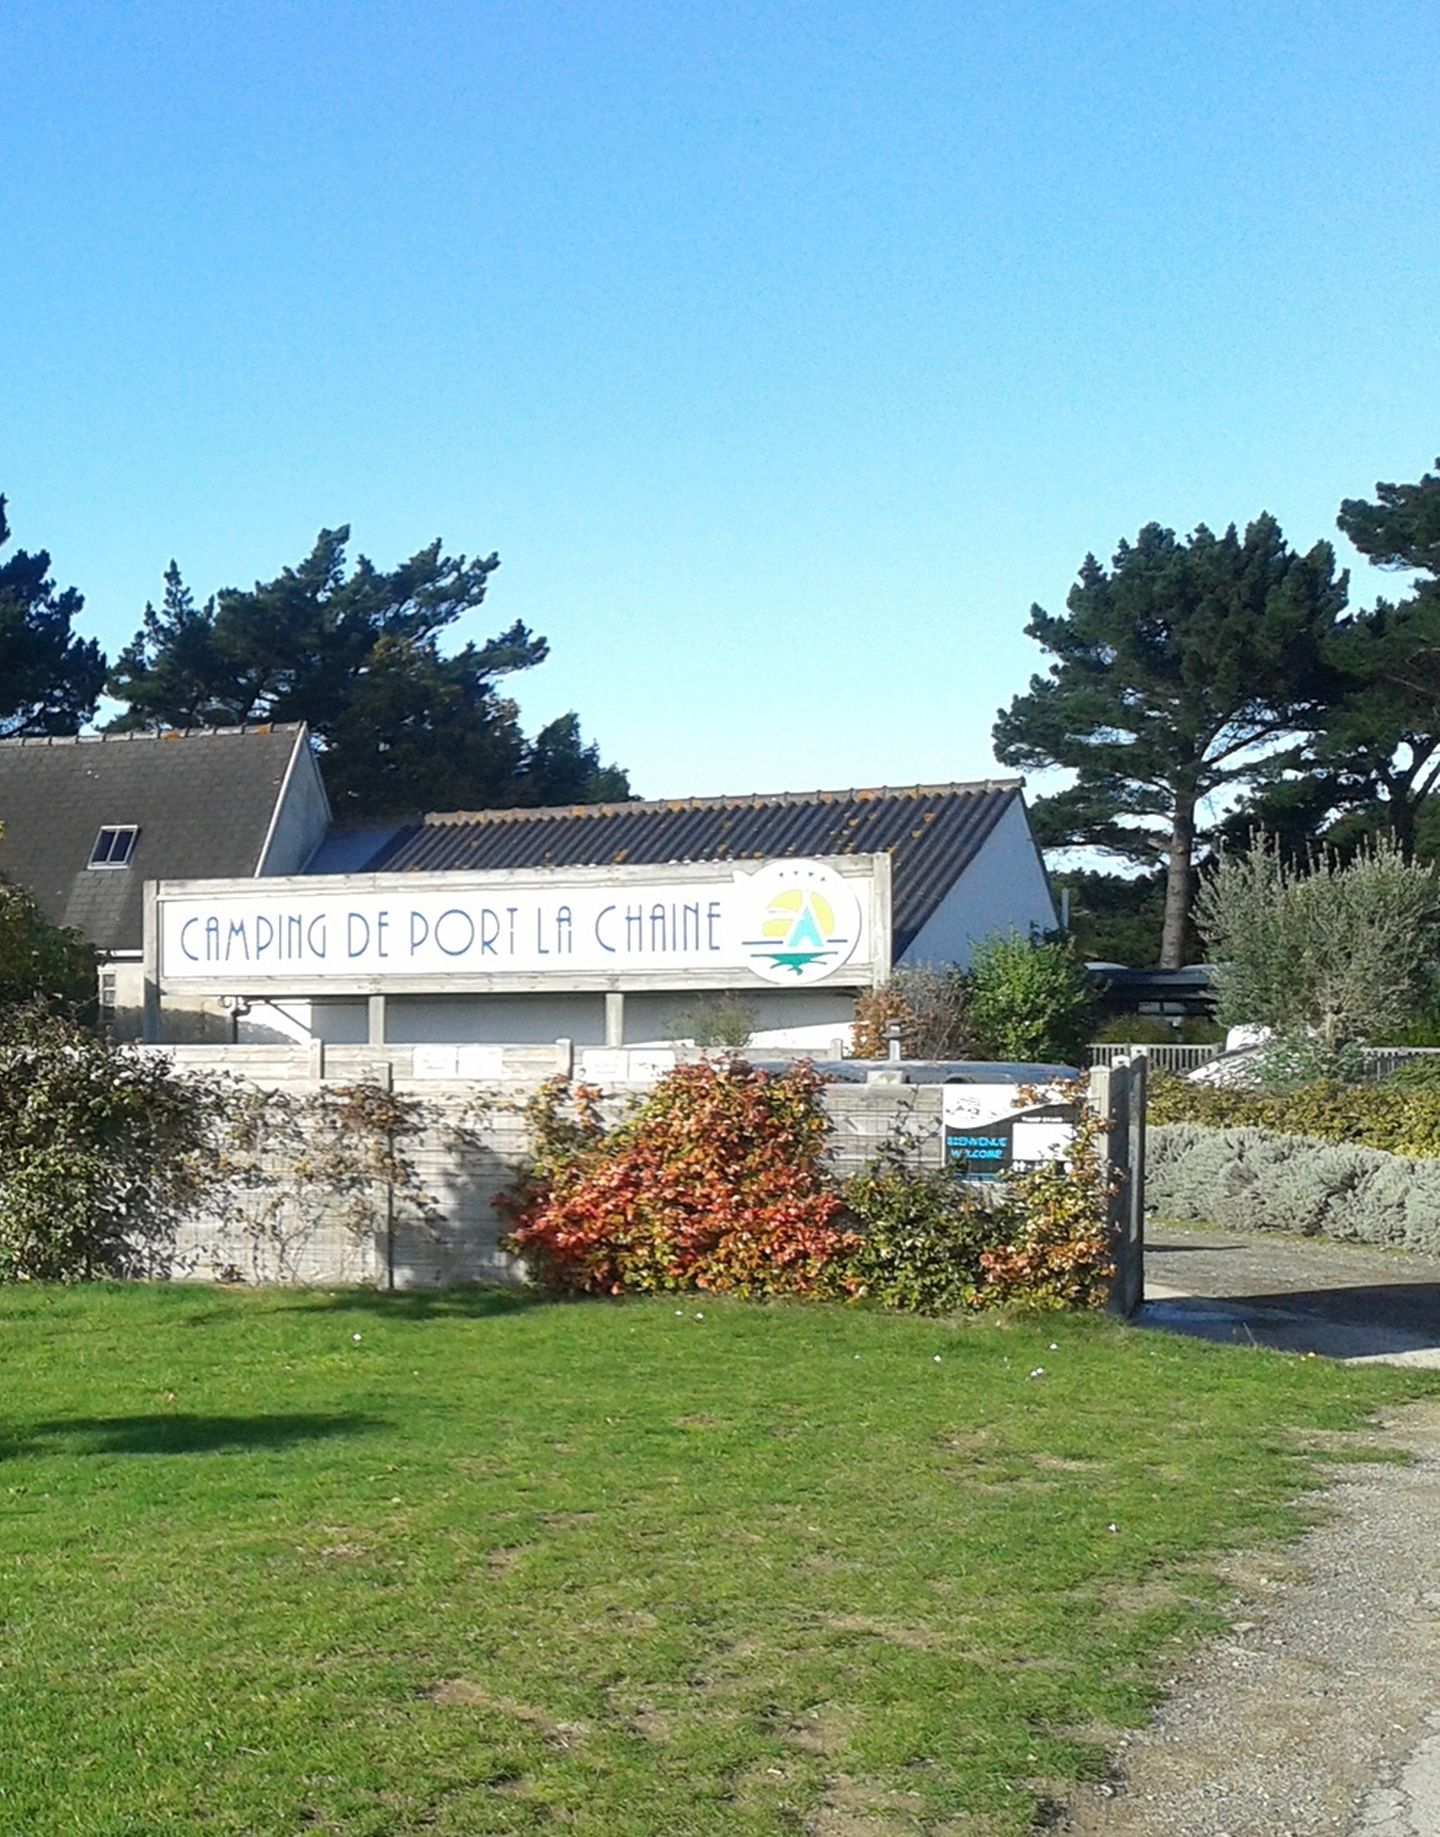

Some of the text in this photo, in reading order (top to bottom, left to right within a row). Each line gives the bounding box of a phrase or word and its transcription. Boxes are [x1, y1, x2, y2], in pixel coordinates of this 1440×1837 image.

[180, 902, 721, 961] CAMPING DE PORT LA CHAINE
